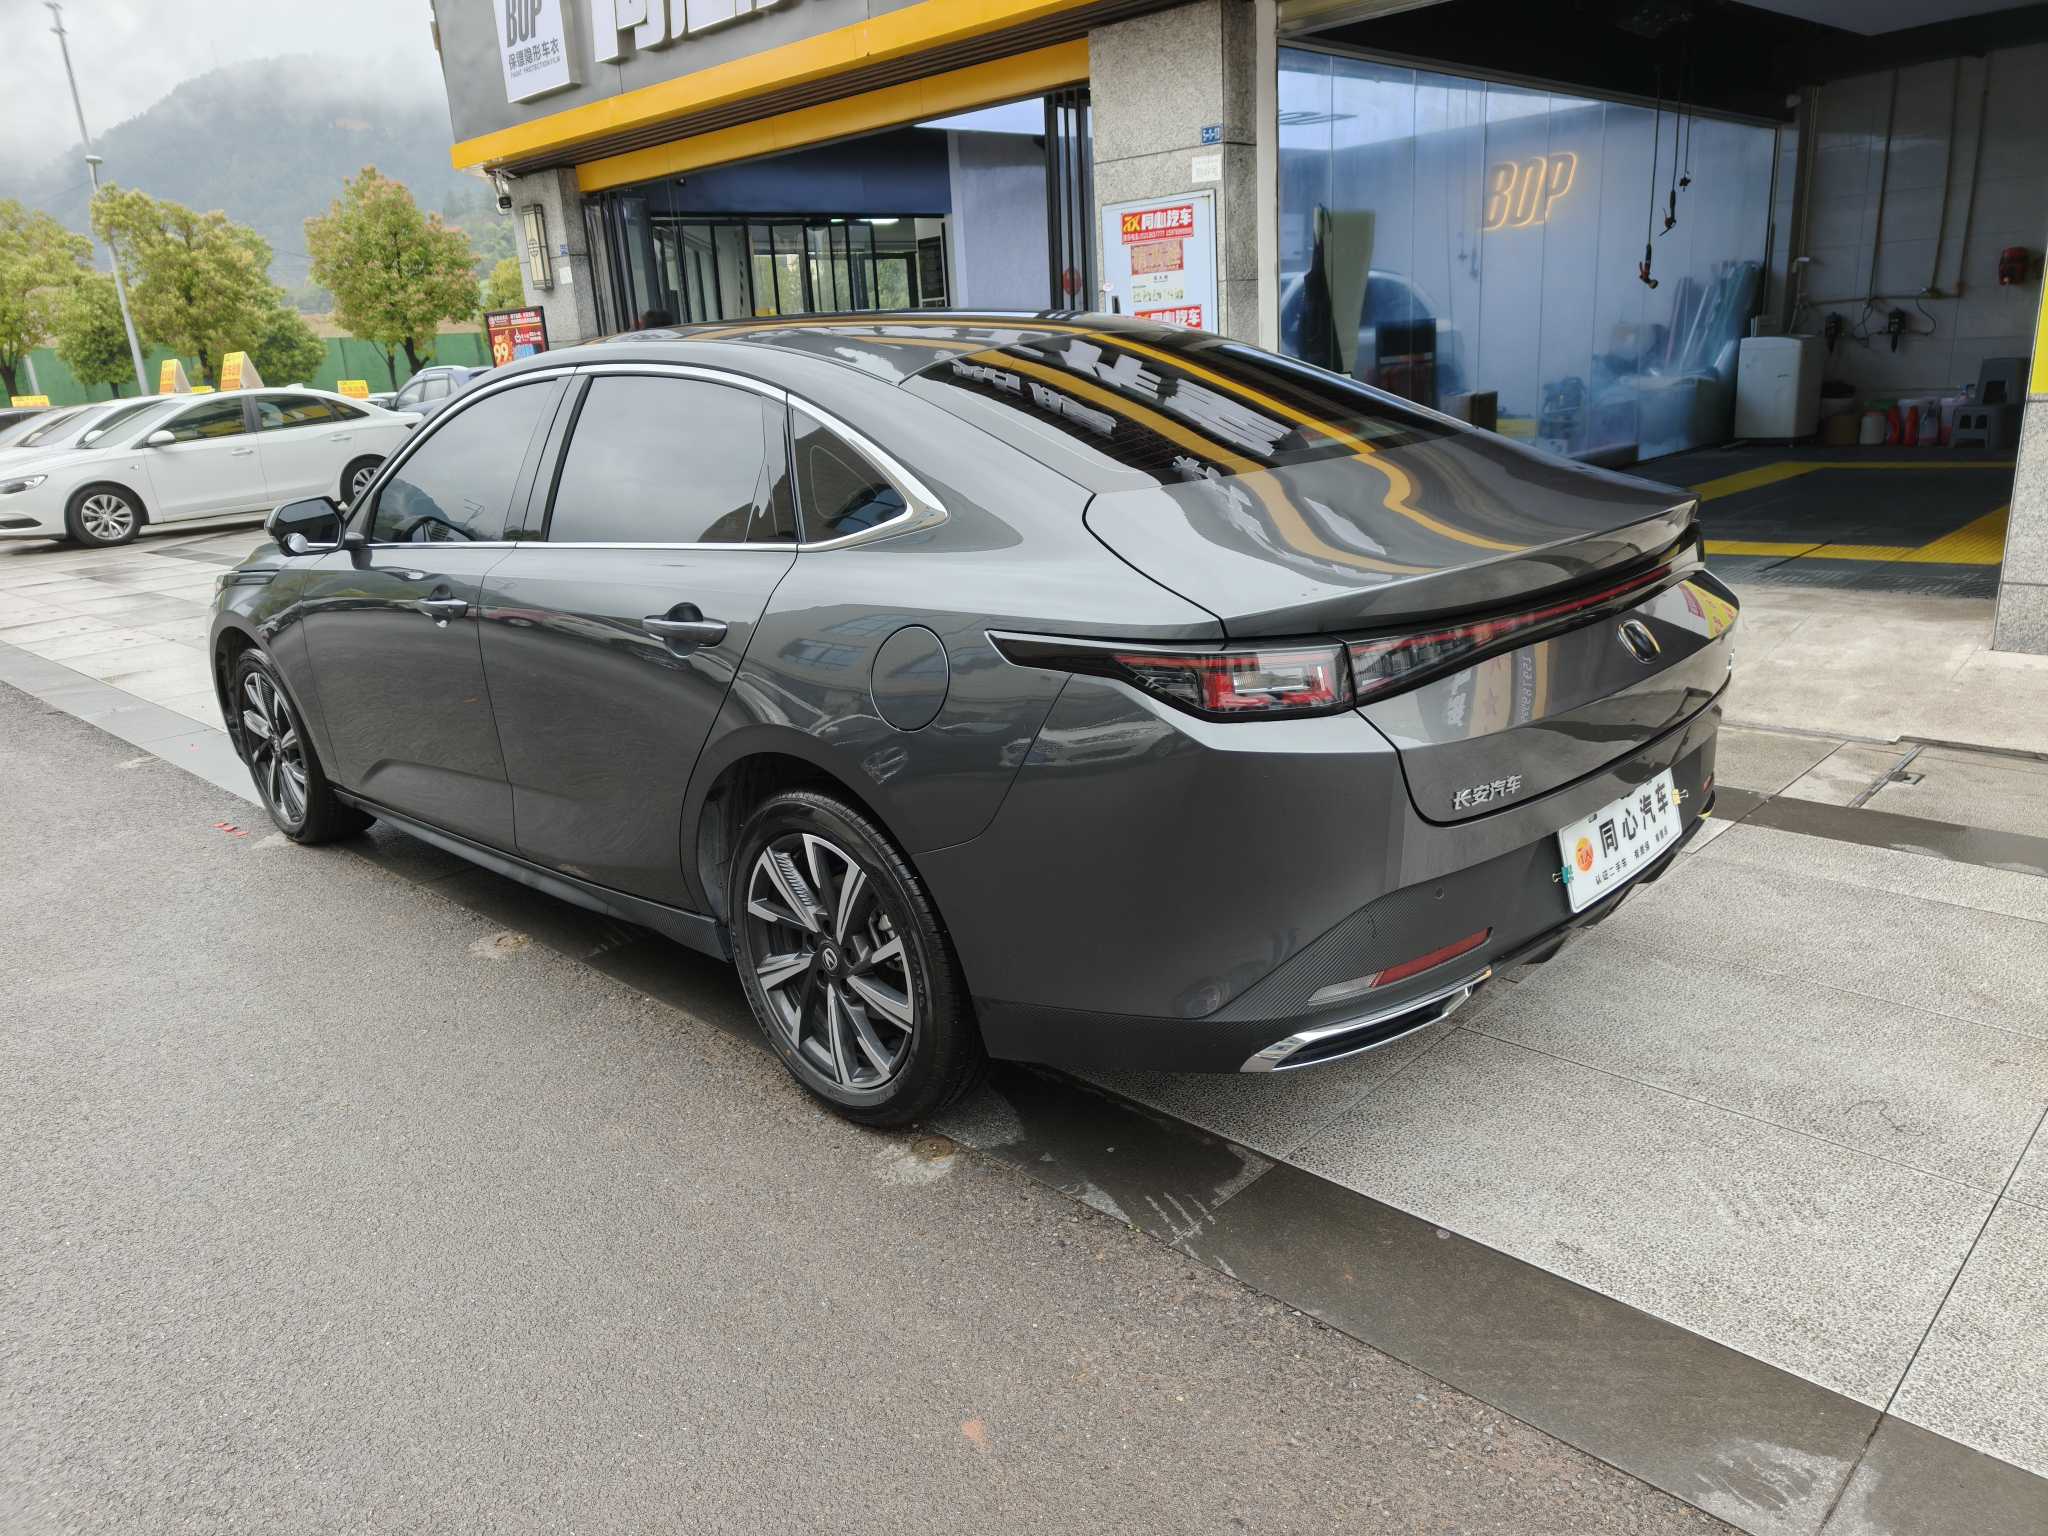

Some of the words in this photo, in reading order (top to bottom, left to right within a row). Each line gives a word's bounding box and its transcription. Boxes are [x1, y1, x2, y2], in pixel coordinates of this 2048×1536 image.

[505, 0, 542, 48] BOP
[1482, 152, 1577, 231] BOP
[1141, 207, 1192, 231] 同心汽车
[1452, 775, 1522, 810] 长安汽车
[1598, 781, 1669, 859] 同心汽车
